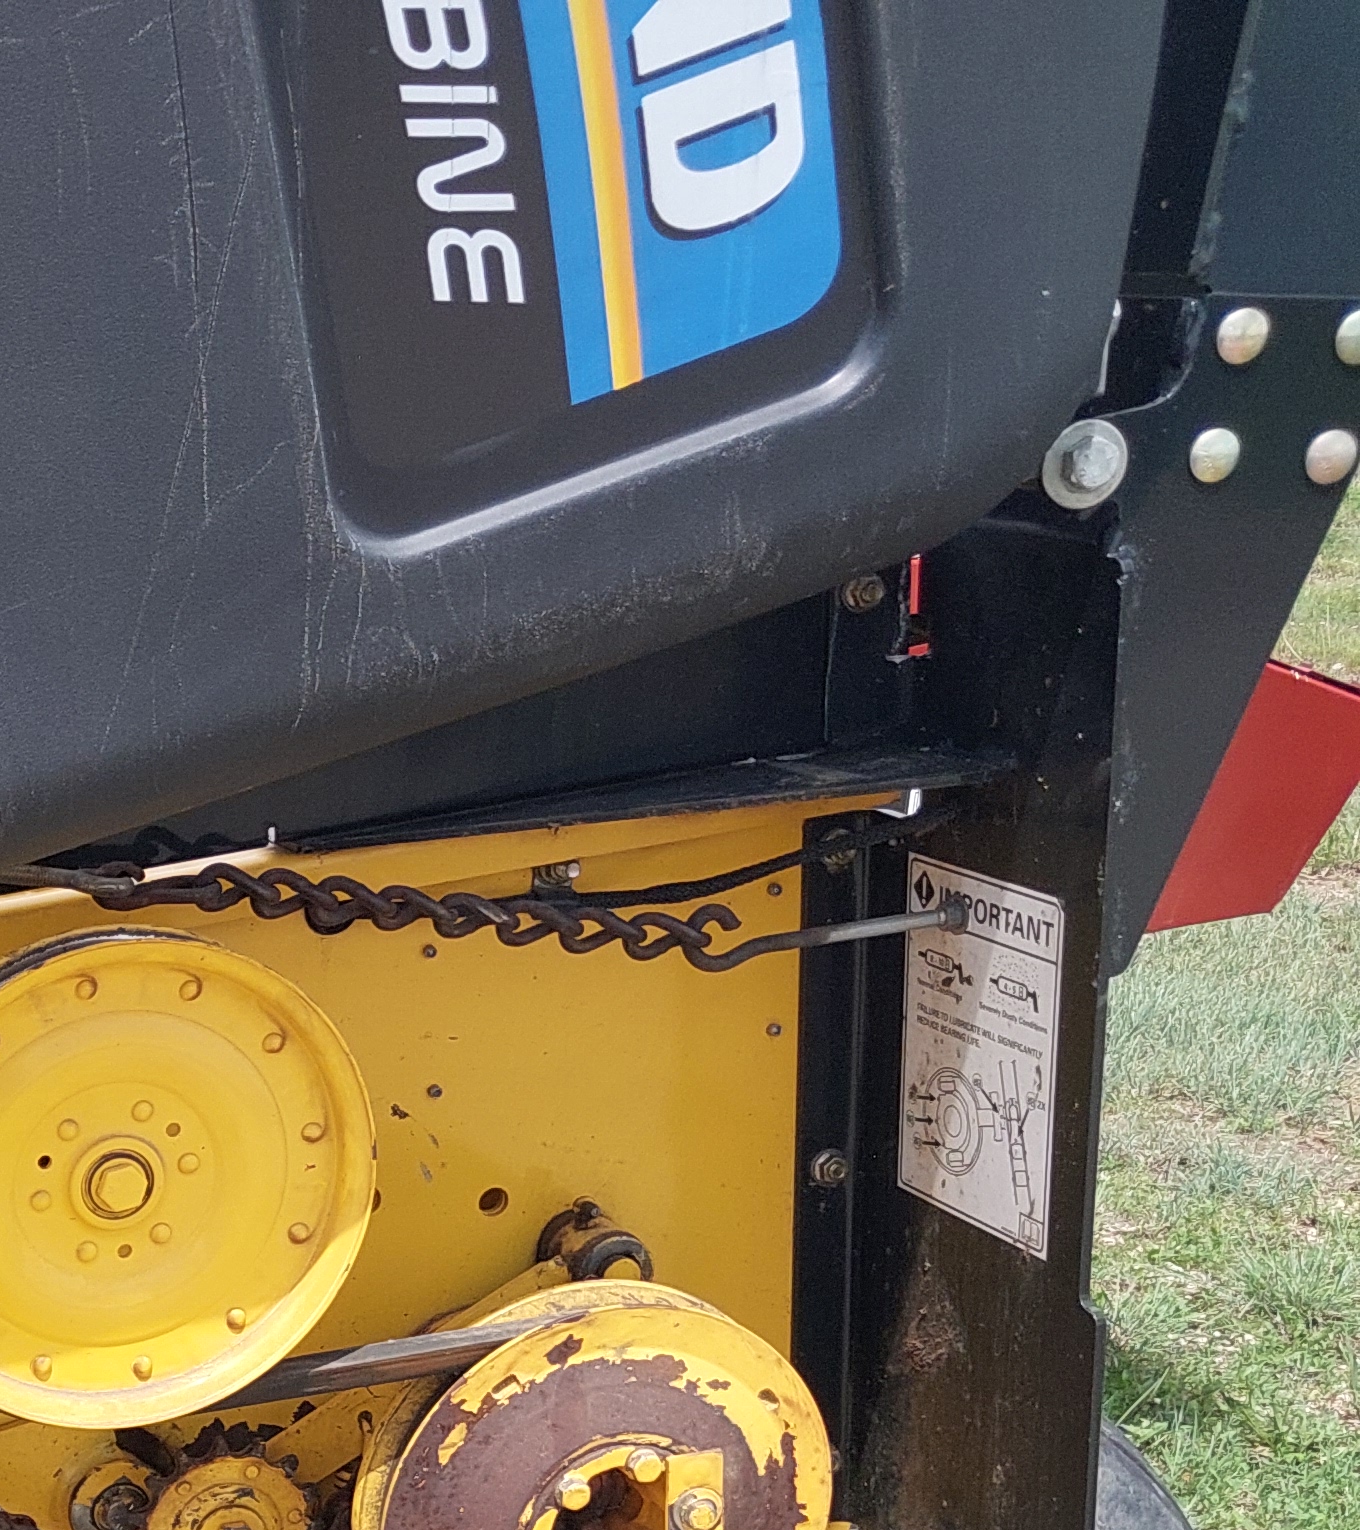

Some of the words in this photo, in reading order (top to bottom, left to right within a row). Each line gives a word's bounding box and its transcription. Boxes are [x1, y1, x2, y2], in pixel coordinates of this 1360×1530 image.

[383, 0, 526, 304] BINE
[916, 1014, 940, 1031] REDUCE
[940, 1022, 966, 1042] BEARING
[949, 1014, 981, 1036] LUBRICATE
[981, 1028, 996, 1042] WILL
[997, 1034, 1044, 1060] SIGNIFICANTLY
